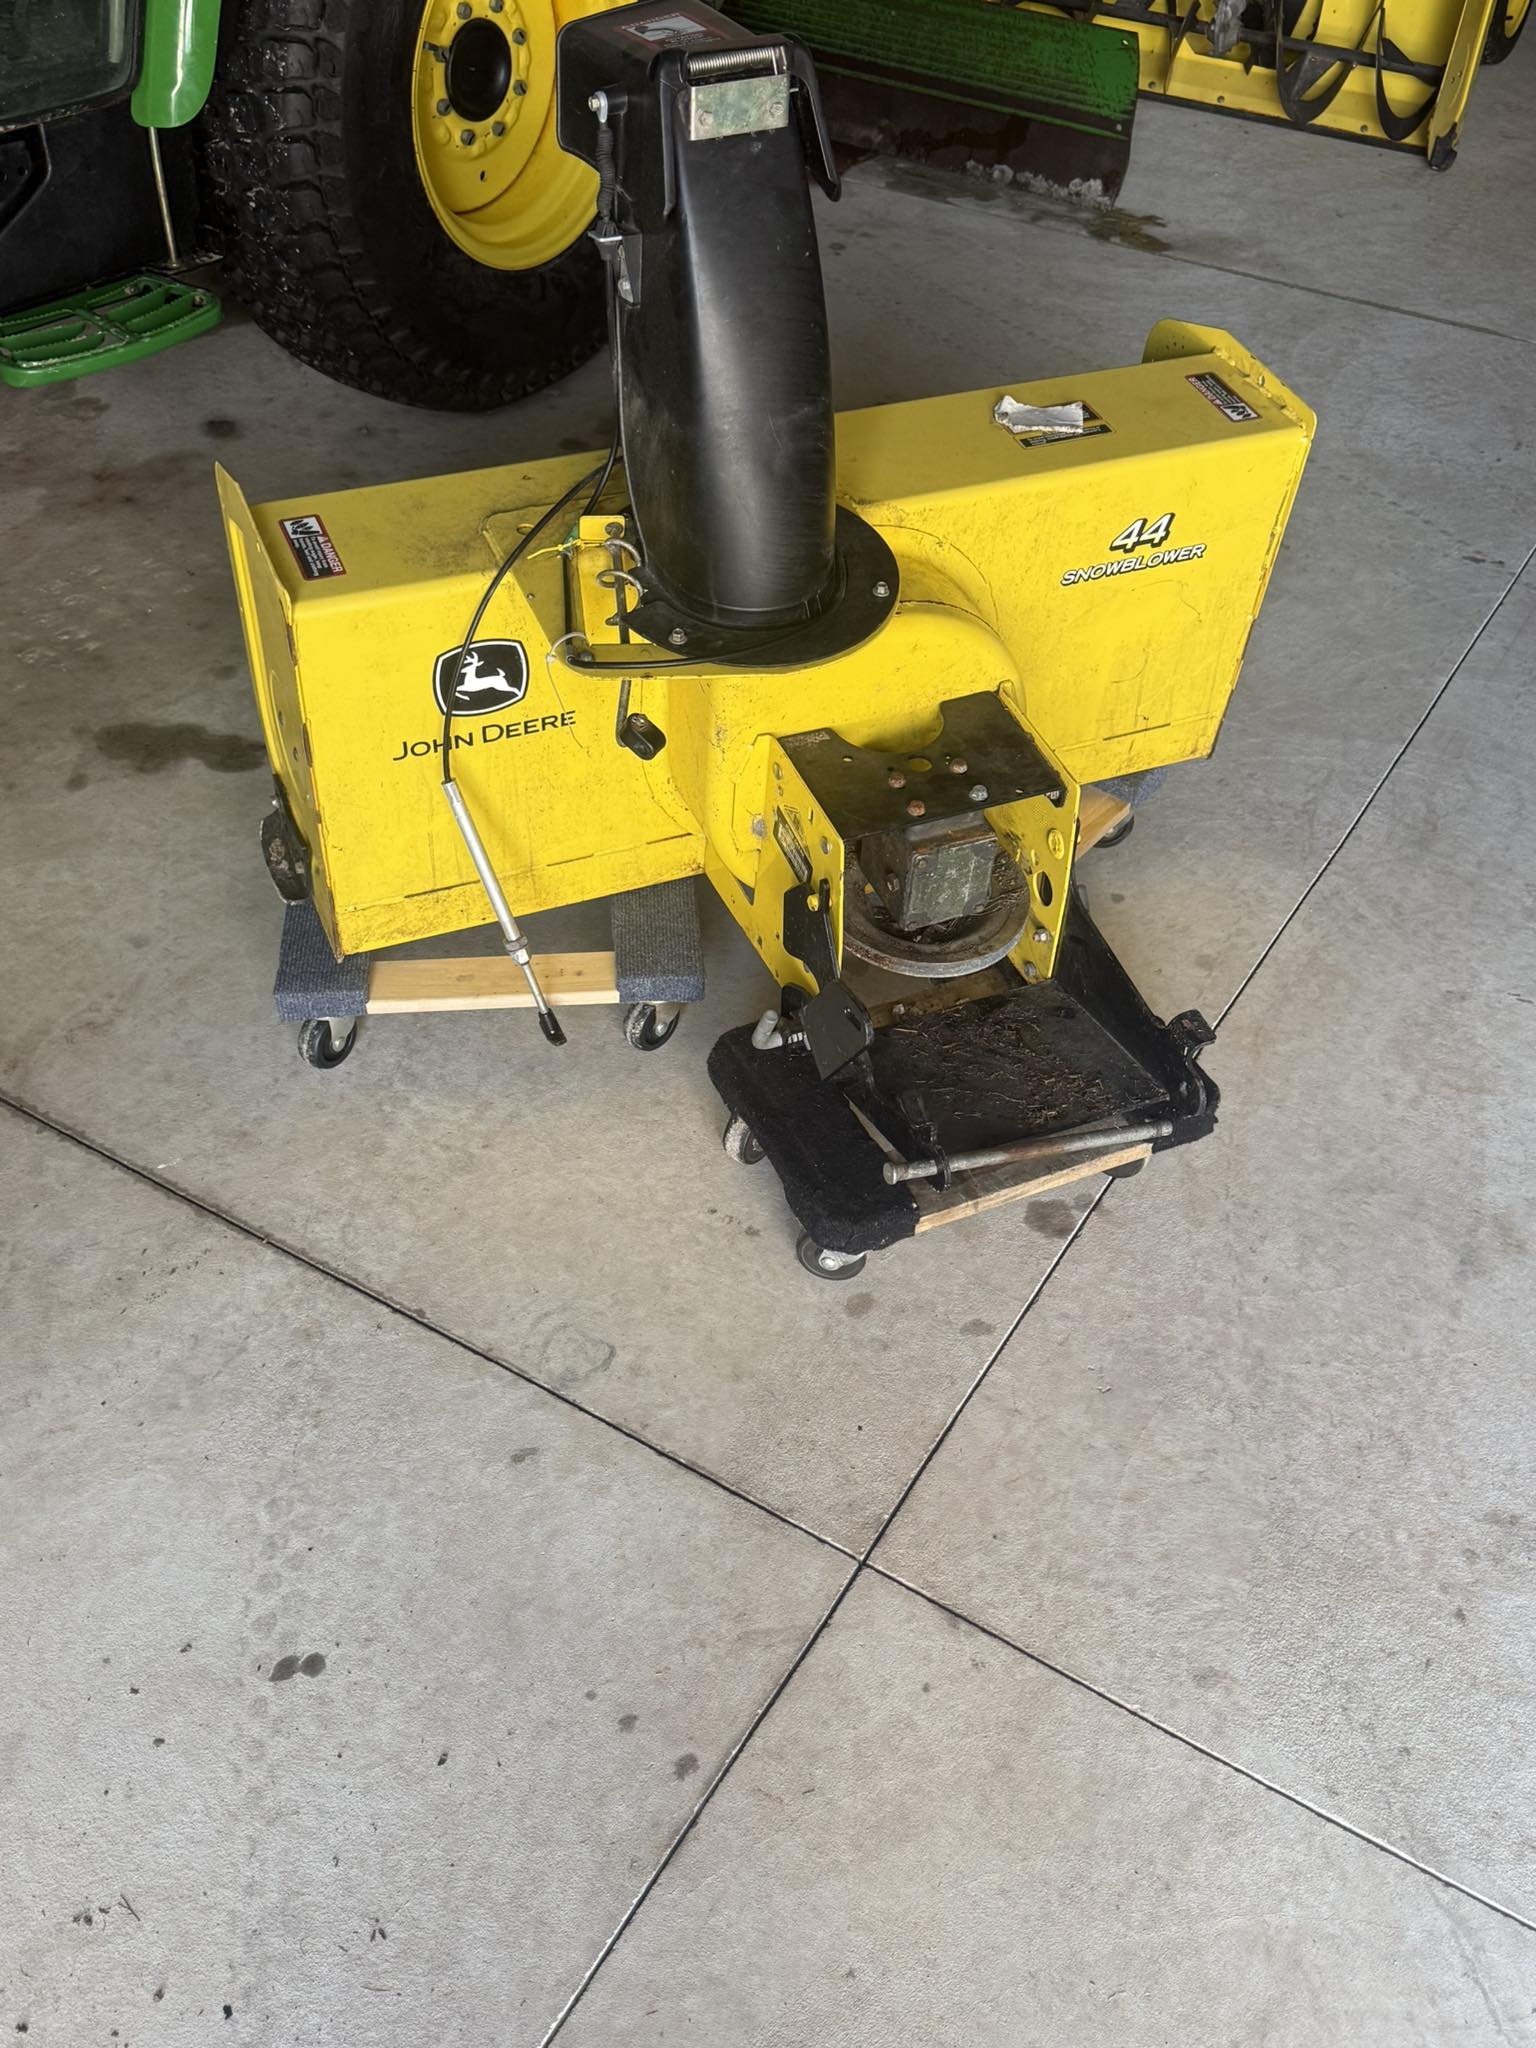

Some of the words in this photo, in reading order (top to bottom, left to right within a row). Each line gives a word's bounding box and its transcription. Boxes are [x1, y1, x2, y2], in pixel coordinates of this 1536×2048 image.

[1109, 512, 1175, 553] 44
[320, 542, 343, 573] DANGER
[1060, 543, 1207, 586] SNOWBLOWER
[393, 732, 474, 761] JOHN
[482, 710, 576, 743] DEERE
